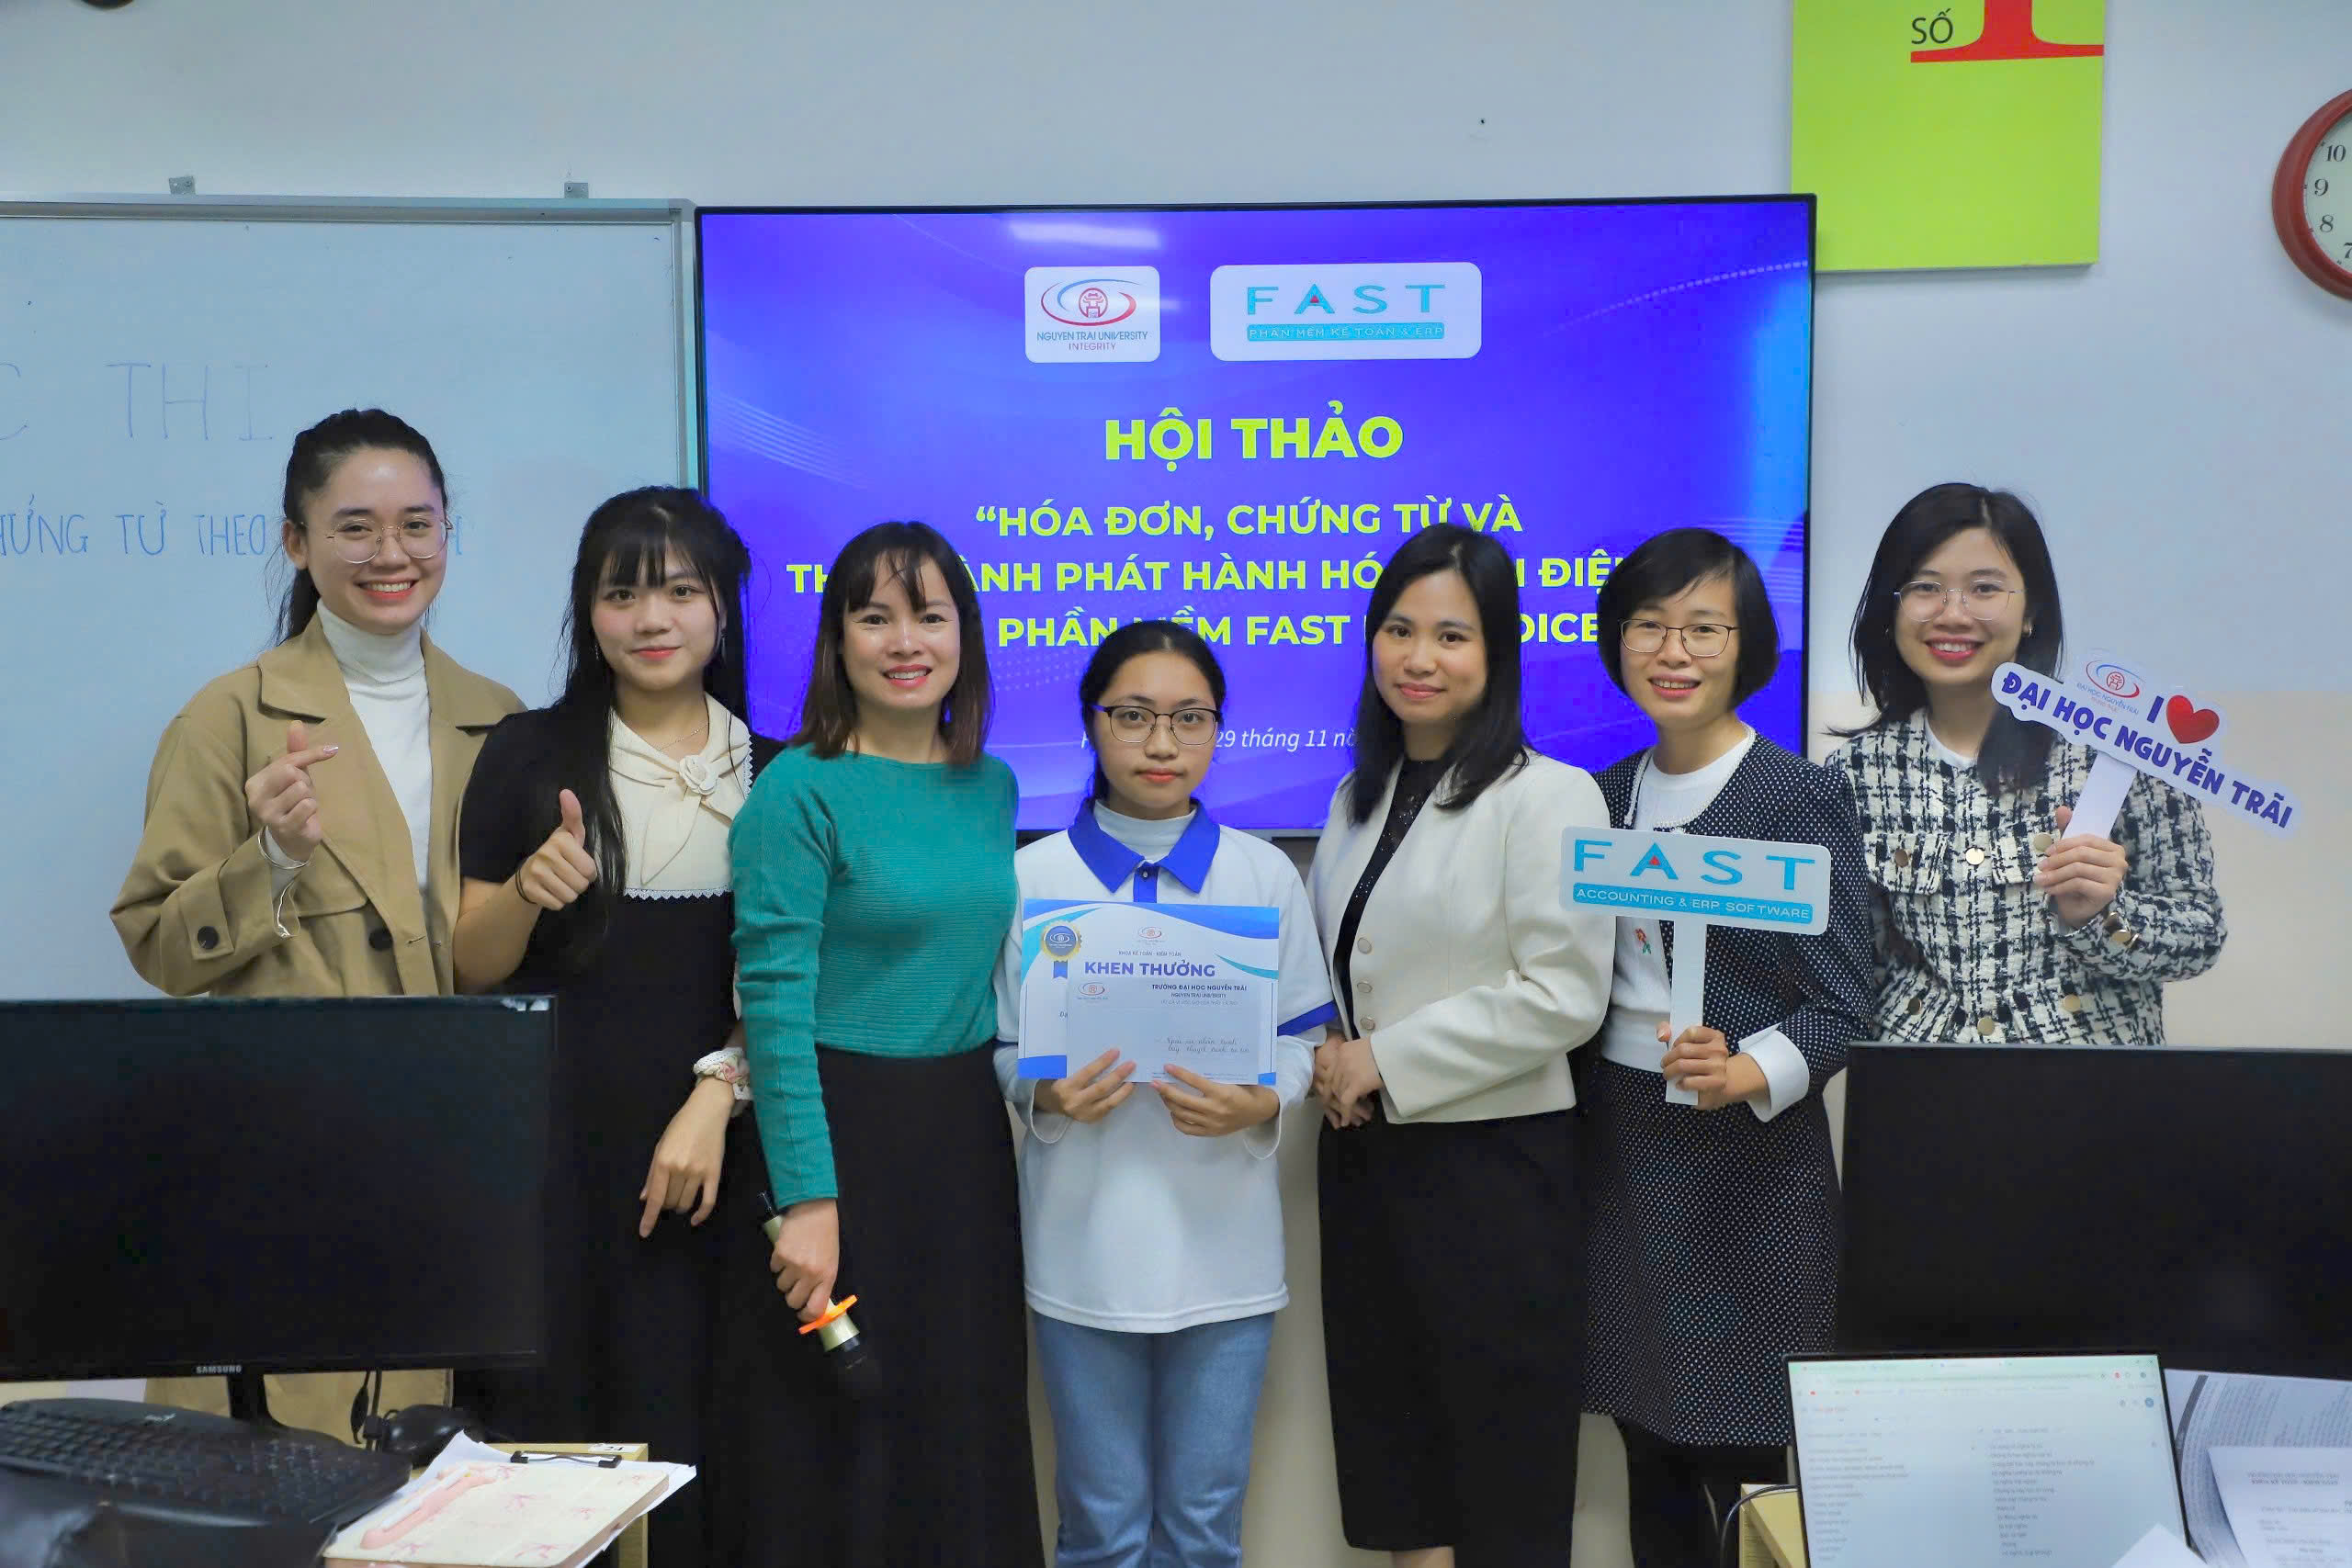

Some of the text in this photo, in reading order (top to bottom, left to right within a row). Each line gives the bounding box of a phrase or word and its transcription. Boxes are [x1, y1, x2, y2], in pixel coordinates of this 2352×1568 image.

[1911, 8, 1953, 44] SỐ
[2325, 144, 2346, 163] 10
[2314, 178, 2329, 197] 9
[2320, 214, 2334, 233] 8
[1246, 283, 1446, 315] FAST
[1036, 331, 1148, 341] NGUYEN TRAI UNIVERSITY
[1069, 342, 1116, 351] INTEGRITY
[104, 363, 273, 441] THI
[1105, 400, 1404, 473] HỘI THẢO
[115, 501, 167, 556] TỪ
[194, 513, 266, 556] THEO
[1104, 500, 1216, 541] ĐƠN,
[1227, 495, 1381, 536] CHỨNG
[1393, 494, 1453, 534] TỪ
[1461, 493, 1523, 533] VÀ
[1056, 553, 1170, 592] PHÁT
[1183, 552, 1306, 590] HÀNH
[1321, 550, 1385, 590] HÓ
[1537, 548, 1624, 595] ĐIỆ
[998, 605, 1118, 648] PHẦN
[1246, 614, 1351, 645] FAST
[2146, 695, 2165, 724] I
[1241, 727, 1299, 751] tháng
[1305, 729, 1328, 747] 11
[2001, 671, 2293, 829] ĐẠI HỌC NGUYỄN TRÃI
[1573, 839, 1815, 891] FAST
[1577, 888, 1810, 919] ACCOUNTING & ERP SOFTWARE
[1084, 959, 1216, 977] KHEN THƯỞNG
[196, 1365, 242, 1374] SAMSUNG
